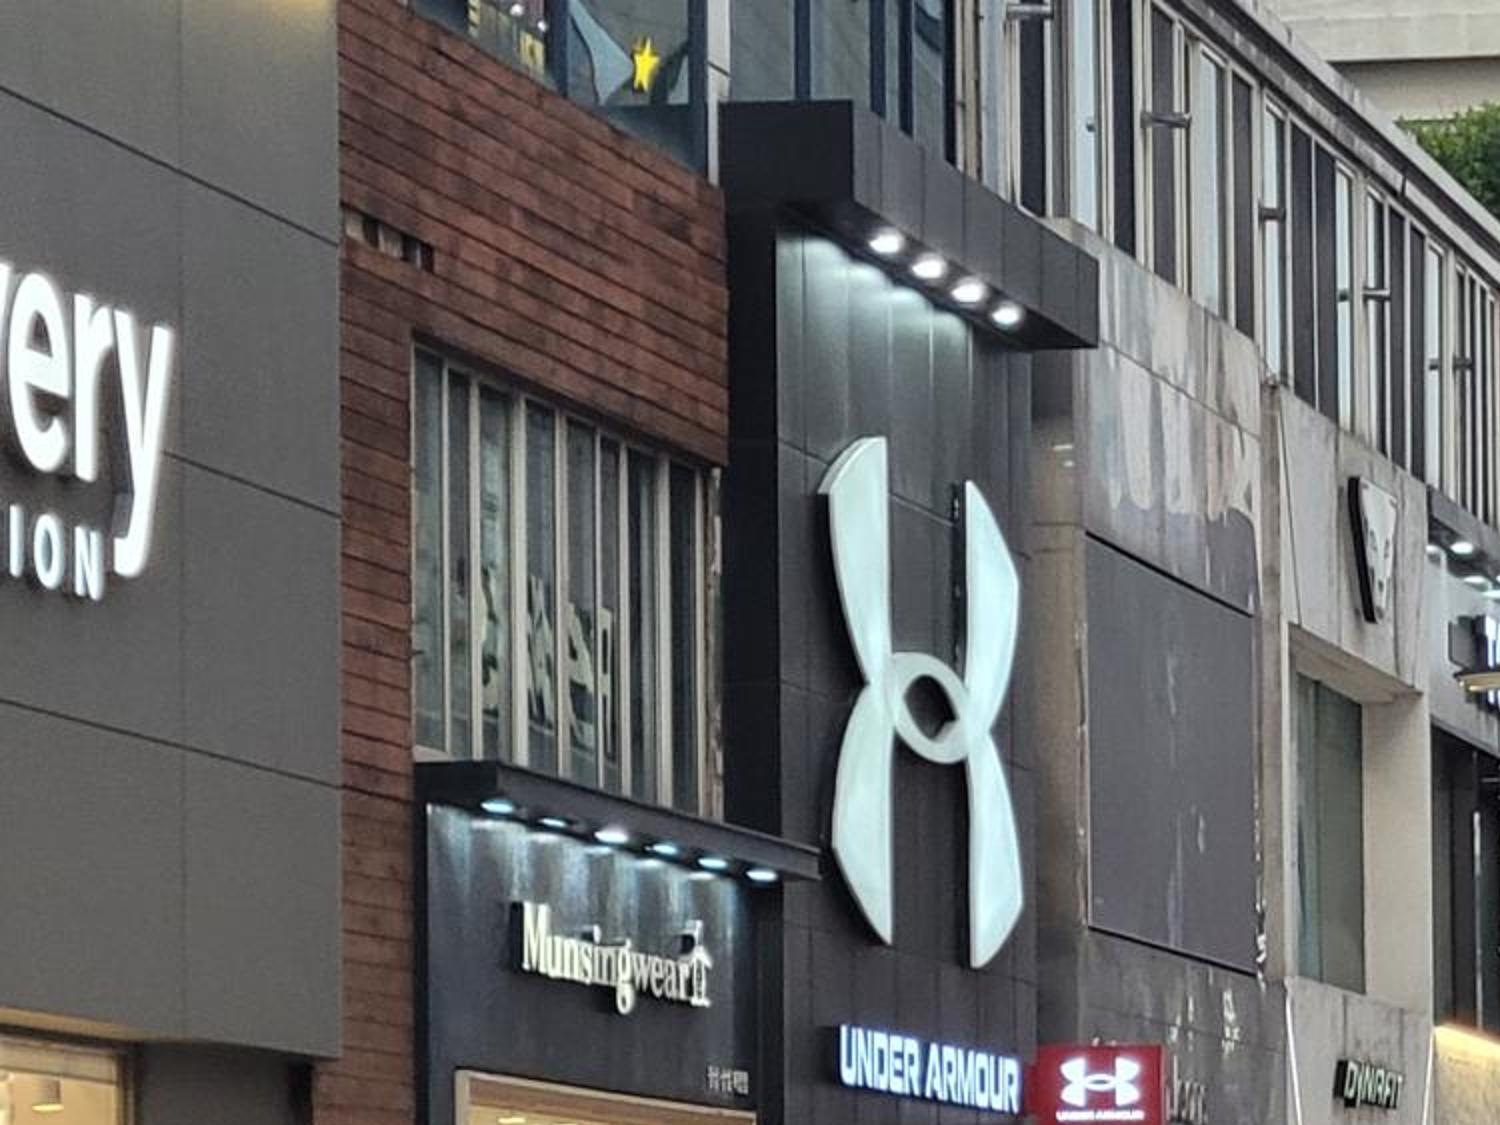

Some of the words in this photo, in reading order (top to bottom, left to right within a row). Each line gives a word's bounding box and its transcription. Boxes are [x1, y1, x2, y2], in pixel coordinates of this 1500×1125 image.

[522, 901, 689, 1015] Munsingwear
[839, 1023, 920, 1095] UNDER
[923, 1041, 1021, 1115] ARMOUR
